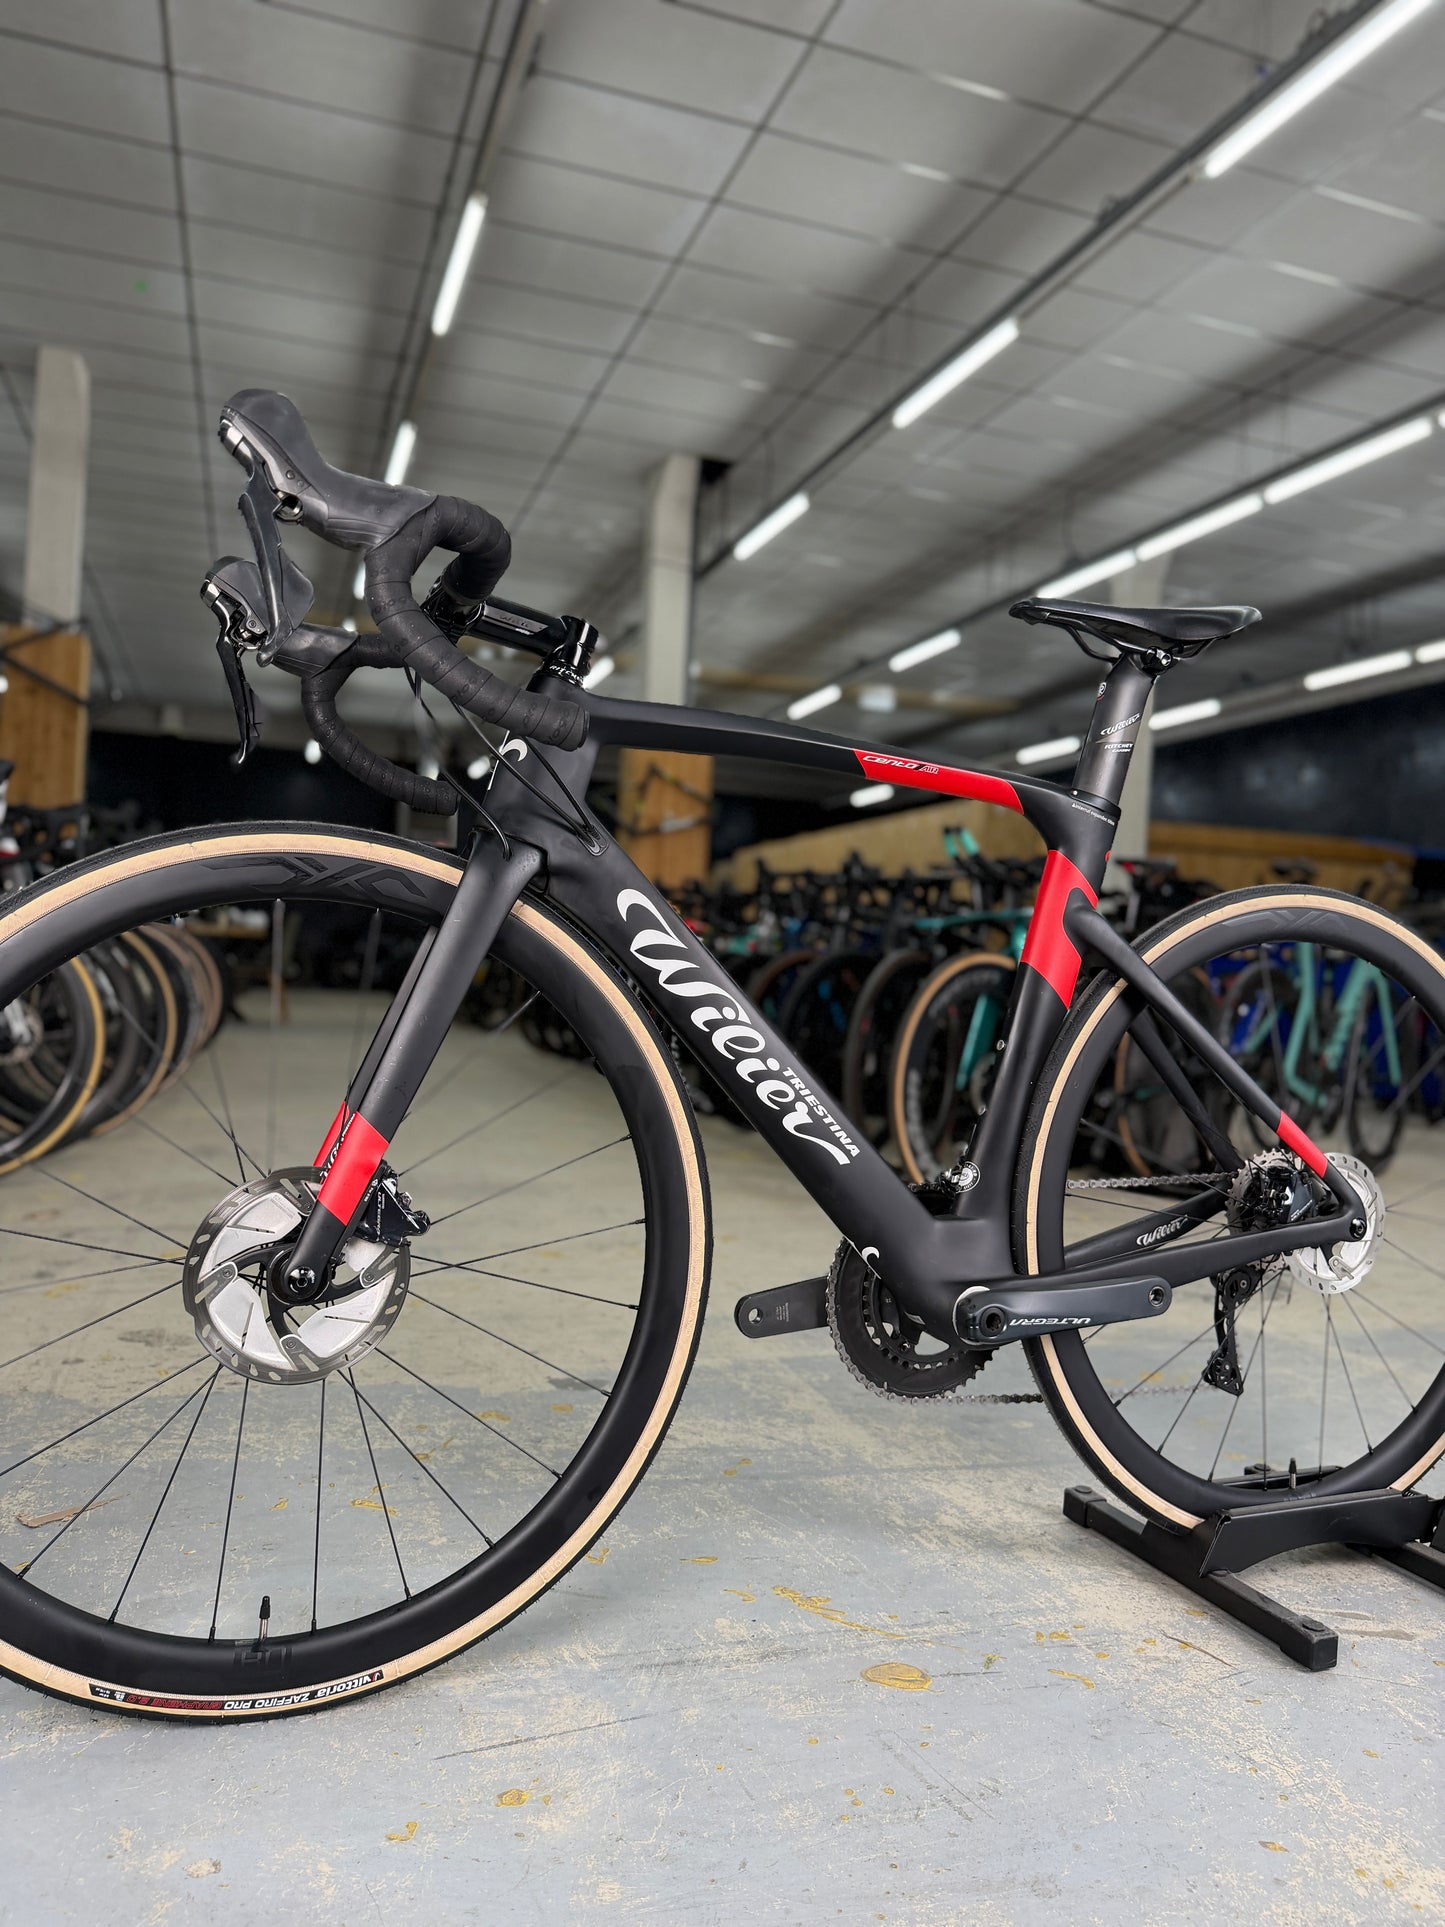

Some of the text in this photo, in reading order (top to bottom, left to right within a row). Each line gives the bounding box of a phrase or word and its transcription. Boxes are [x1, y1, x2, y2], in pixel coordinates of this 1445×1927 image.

[617, 889, 850, 1165] Wilier
[783, 1067, 860, 1157] TRIESTINA
[1137, 1214, 1188, 1246] Wilier
[1010, 1317, 1091, 1326] ULTEGRA
[224, 1701, 252, 1710] PRO
[254, 1692, 310, 1708] ZAFFIRO
